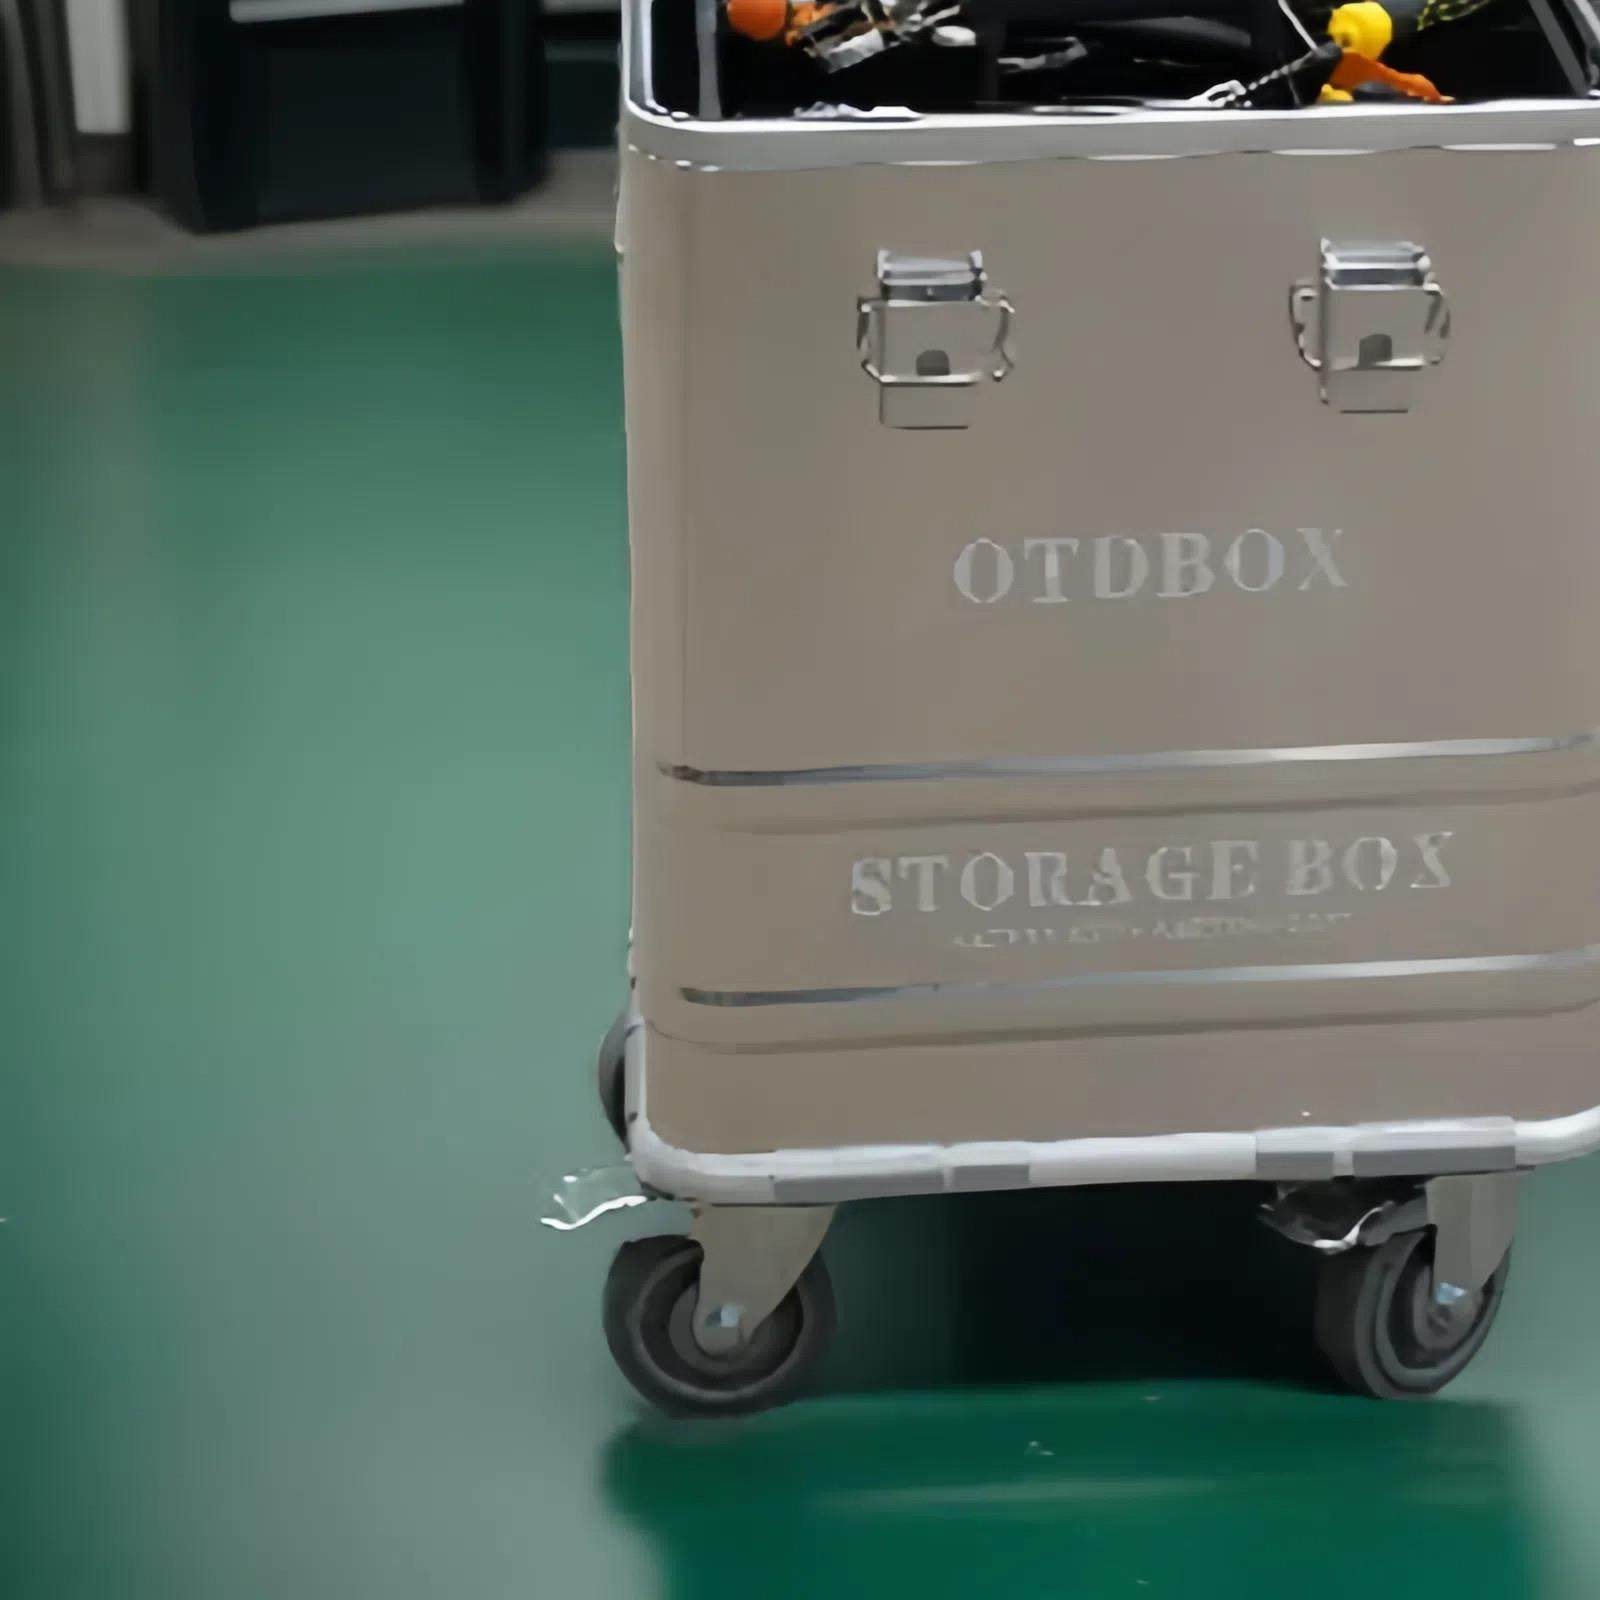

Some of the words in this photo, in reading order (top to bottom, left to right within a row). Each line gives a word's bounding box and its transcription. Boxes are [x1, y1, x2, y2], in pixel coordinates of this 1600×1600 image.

[954, 527, 1348, 604] OTDBOX
[850, 839, 1260, 917] STORAGE
[1286, 831, 1455, 896] BOX
